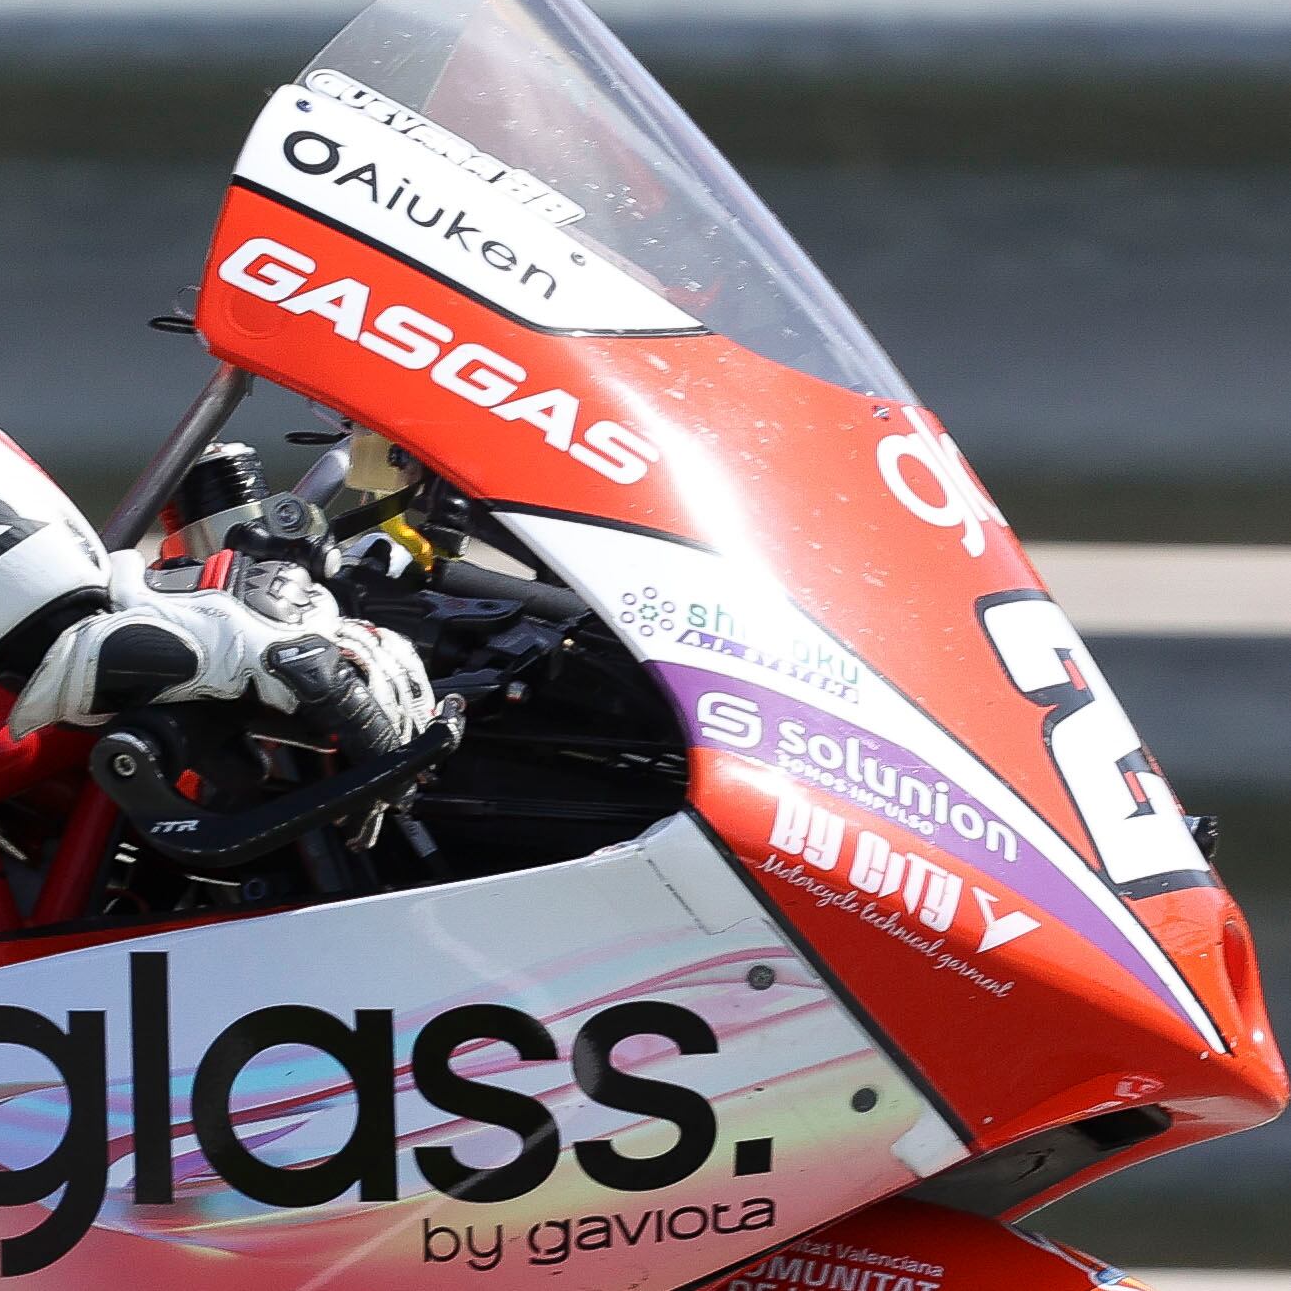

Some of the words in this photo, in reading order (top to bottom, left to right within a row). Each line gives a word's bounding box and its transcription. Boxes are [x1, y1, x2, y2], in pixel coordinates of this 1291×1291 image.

[332, 162, 558, 300] Aiuken
[218, 236, 661, 486] GASGAS
[777, 719, 1018, 863] solunion
[756, 853, 859, 914] Motorcycle
[859, 902, 946, 958] technical
[936, 953, 1016, 998] garment
[421, 1215, 505, 1273] by
[527, 1196, 778, 1267] gaviota
